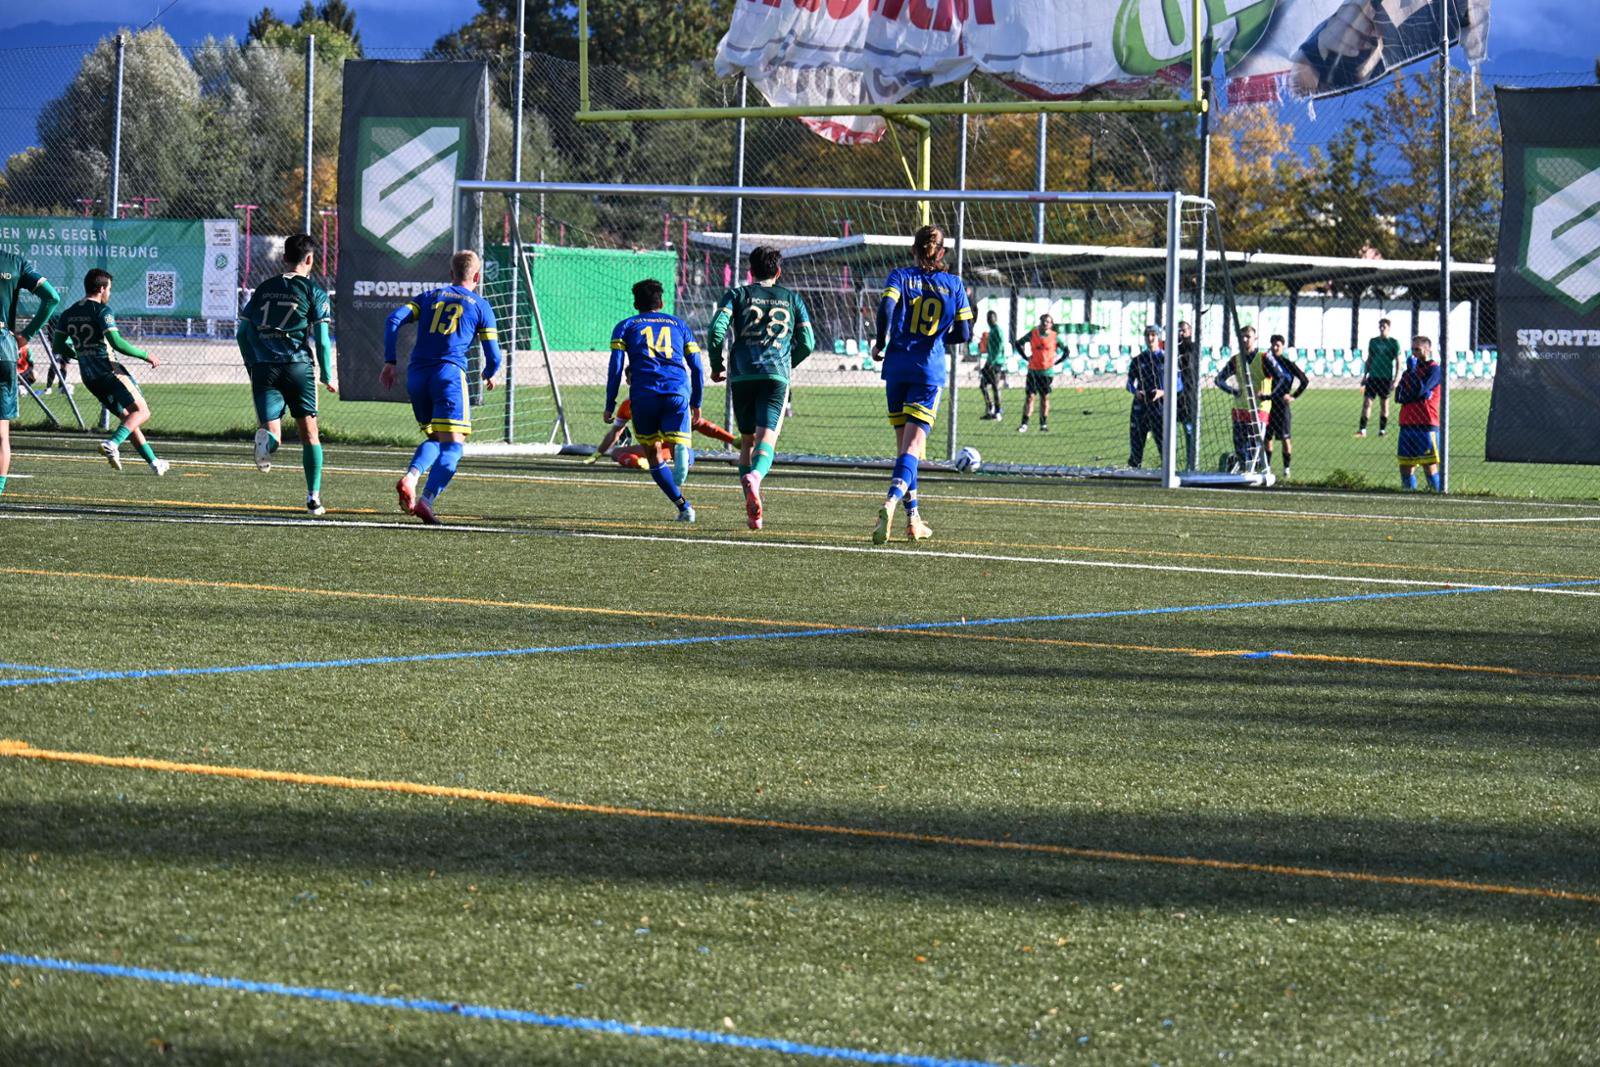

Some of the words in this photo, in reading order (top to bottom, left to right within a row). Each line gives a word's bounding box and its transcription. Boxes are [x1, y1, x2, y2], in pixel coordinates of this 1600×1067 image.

[26, 228, 55, 240] WAS
[61, 228, 107, 241] GEGEN
[31, 244, 158, 258] DISKRIMINIERUNG
[256, 301, 298, 331] 17
[429, 301, 464, 336] 13
[740, 305, 790, 339] 28
[908, 295, 942, 336] 19
[67, 324, 99, 348] 32
[640, 326, 673, 359] 14
